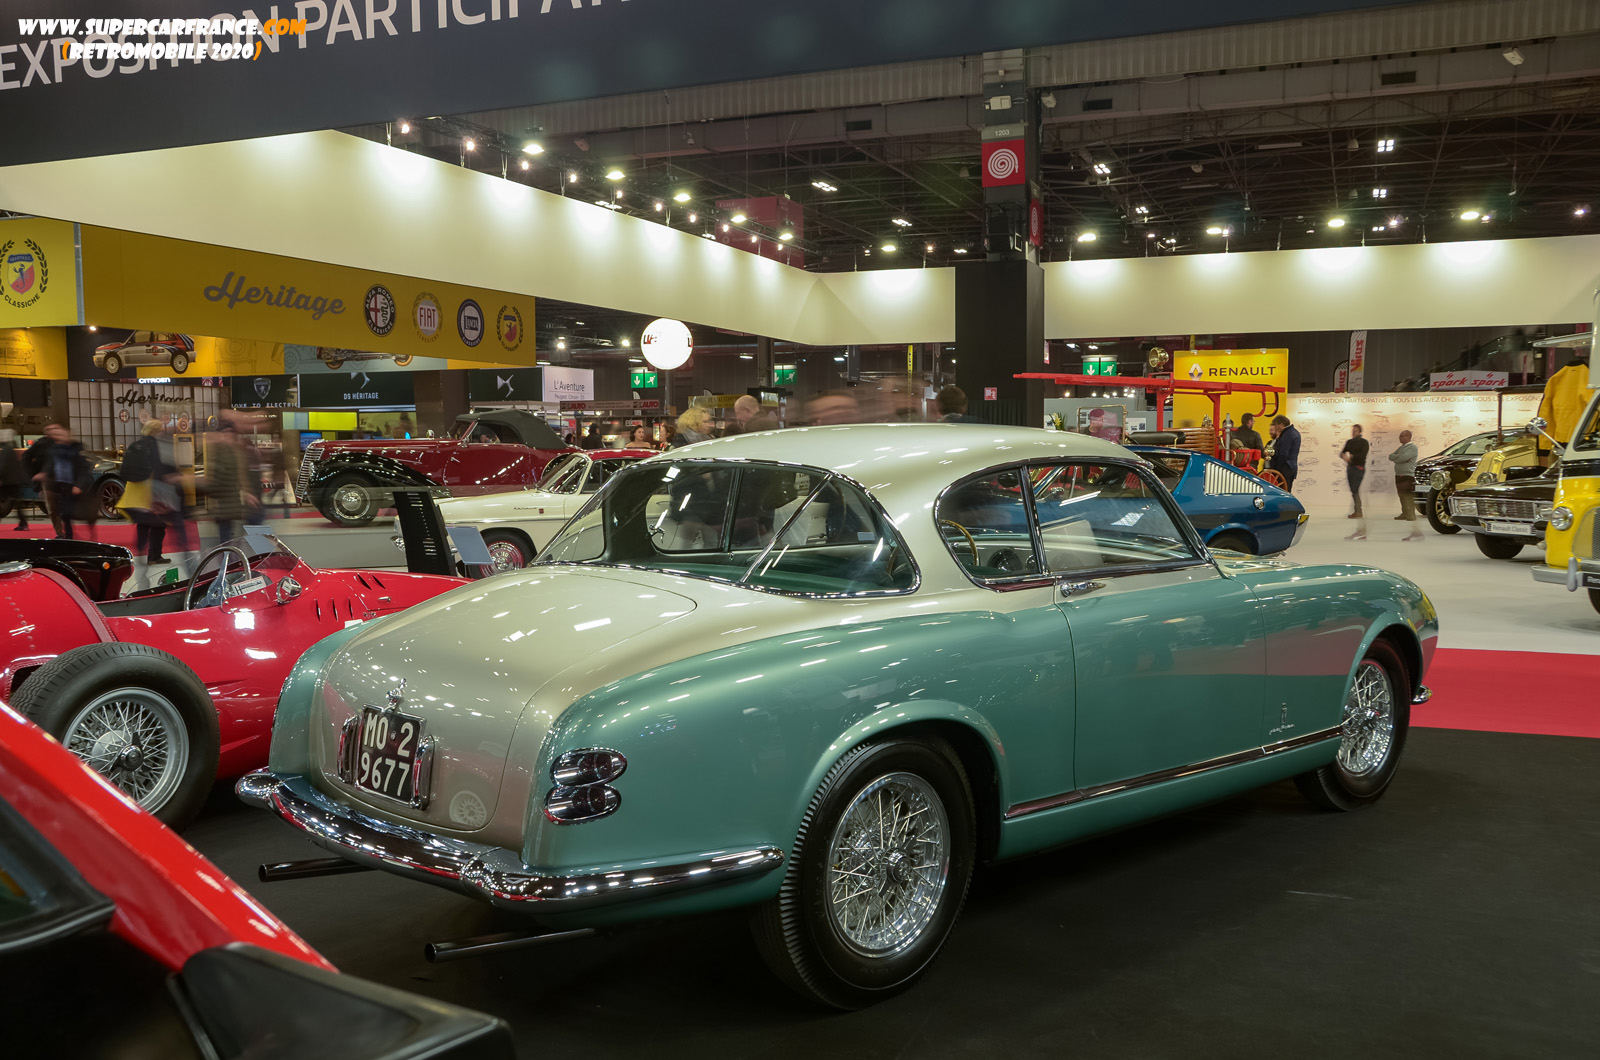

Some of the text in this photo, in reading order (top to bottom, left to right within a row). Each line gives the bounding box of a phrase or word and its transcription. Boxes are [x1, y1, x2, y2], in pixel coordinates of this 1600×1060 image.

[4, 293, 41, 309] CLASSICHE
[204, 271, 346, 320] Heritage
[365, 287, 395, 313] ALFA ROMEO
[419, 307, 436, 328] FIAT
[1208, 366, 1276, 377] RENAULT
[554, 380, 585, 391] L'Aventure
[1429, 377, 1507, 389] spark spark
[343, 391, 379, 400] DS HÉRITAGE
[364, 712, 414, 758] MO 2
[360, 752, 410, 797] 9677
